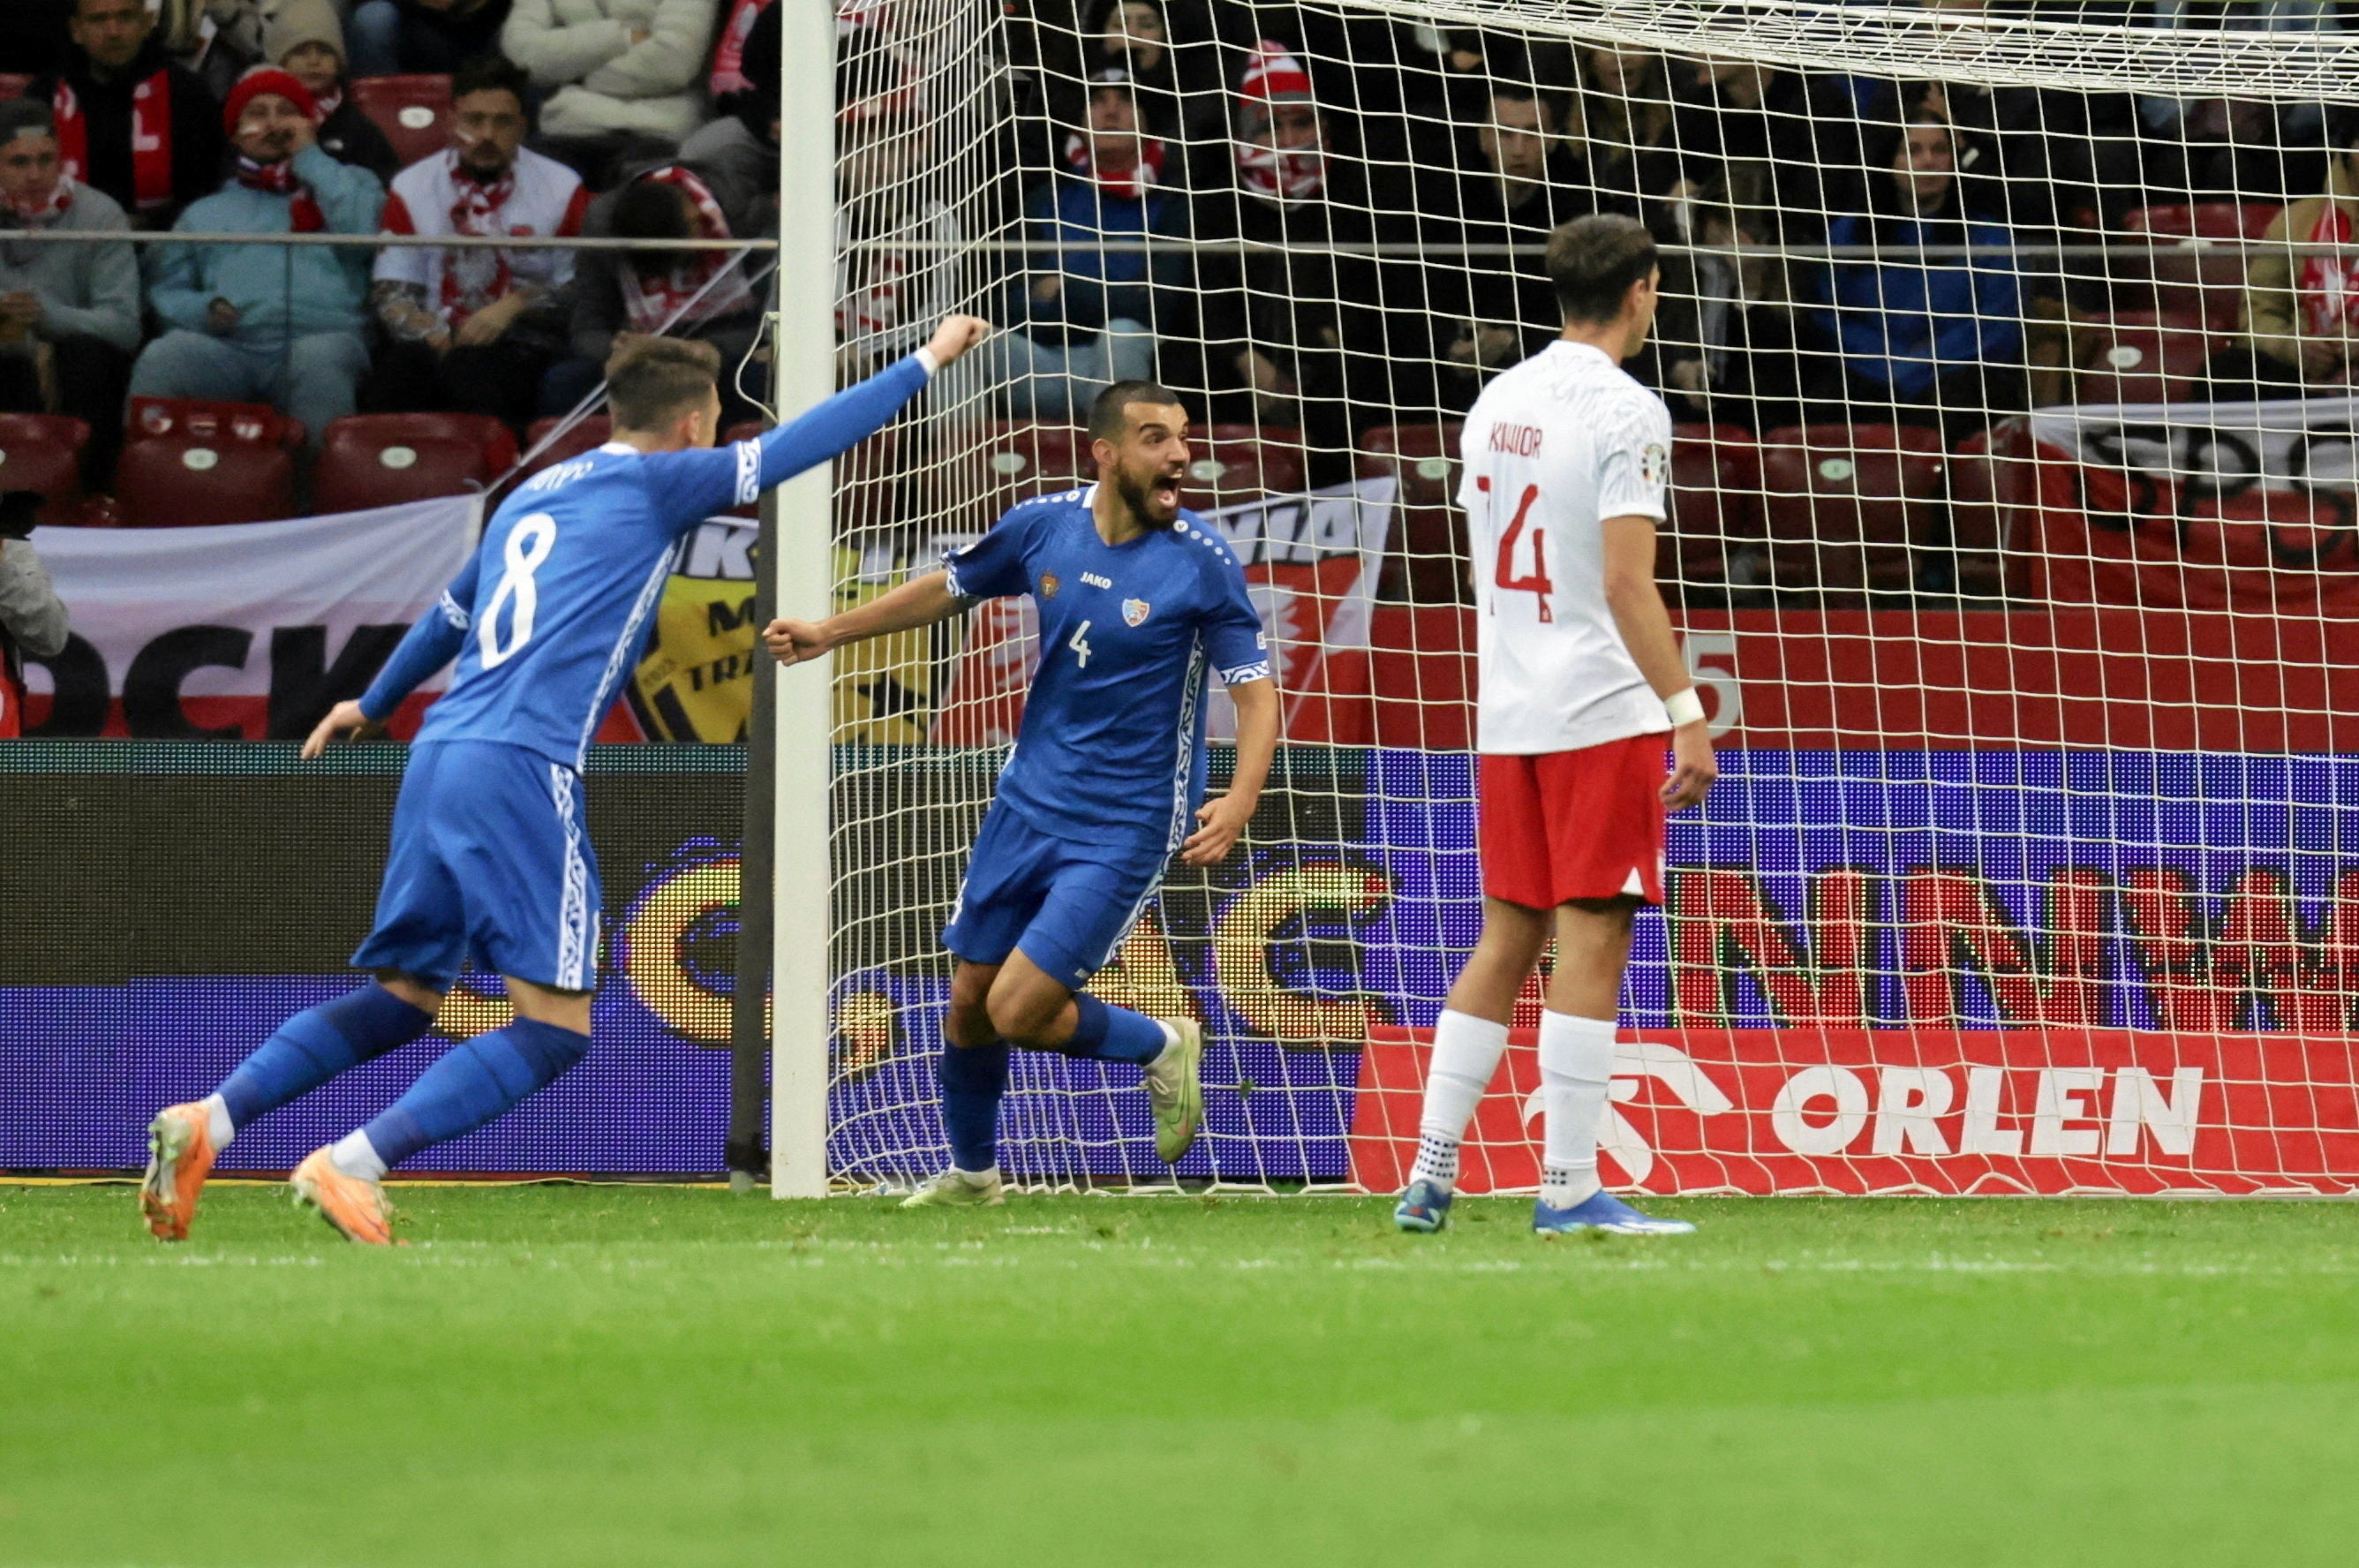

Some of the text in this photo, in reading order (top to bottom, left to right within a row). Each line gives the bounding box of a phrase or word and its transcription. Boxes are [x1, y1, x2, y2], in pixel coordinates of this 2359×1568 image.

[479, 512, 558, 671] 8
[1080, 571, 1112, 590] JAKO
[1069, 620, 1091, 668] 4
[1771, 1065, 2204, 1155] ORLEN
